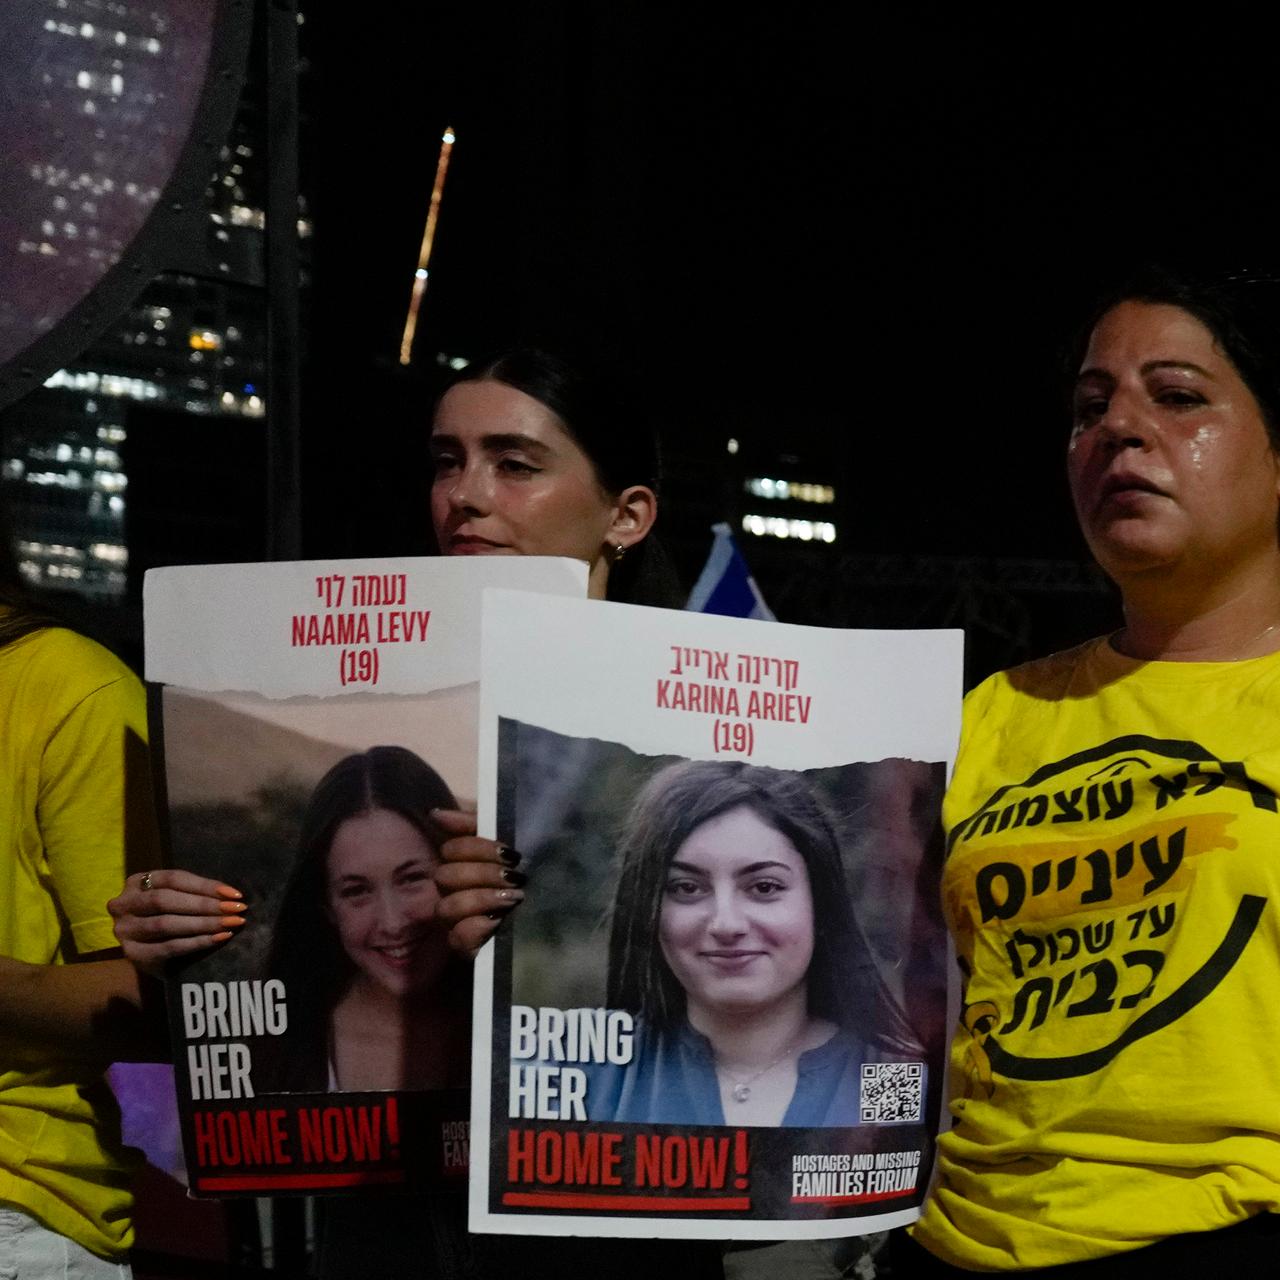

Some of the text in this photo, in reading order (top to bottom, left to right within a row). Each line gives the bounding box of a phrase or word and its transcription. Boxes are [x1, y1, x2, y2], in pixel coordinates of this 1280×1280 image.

[316, 574, 407, 607] נעמה לוי
[292, 611, 431, 646] NAAMA LEVY
[340, 649, 379, 685] (19)
[670, 646, 799, 688] קרינה ארייב
[656, 679, 812, 724] KARINA ARIEV
[713, 720, 753, 756] (19)
[962, 763, 1225, 842] לא עוצמות
[975, 826, 1188, 923] עיניים
[1127, 903, 1176, 940] עד
[181, 978, 288, 1039] BRING
[509, 1004, 634, 1066] BRING
[186, 1043, 255, 1101] HER
[508, 1066, 588, 1122] HER
[193, 1109, 292, 1167] HOME
[296, 1096, 399, 1165] NOW!
[507, 1128, 625, 1186] HOME
[634, 1129, 751, 1190] NOW!
[792, 1150, 921, 1172] HOSTAGES AND MISSING
[792, 1167, 919, 1197] FAMILIES FORUM
